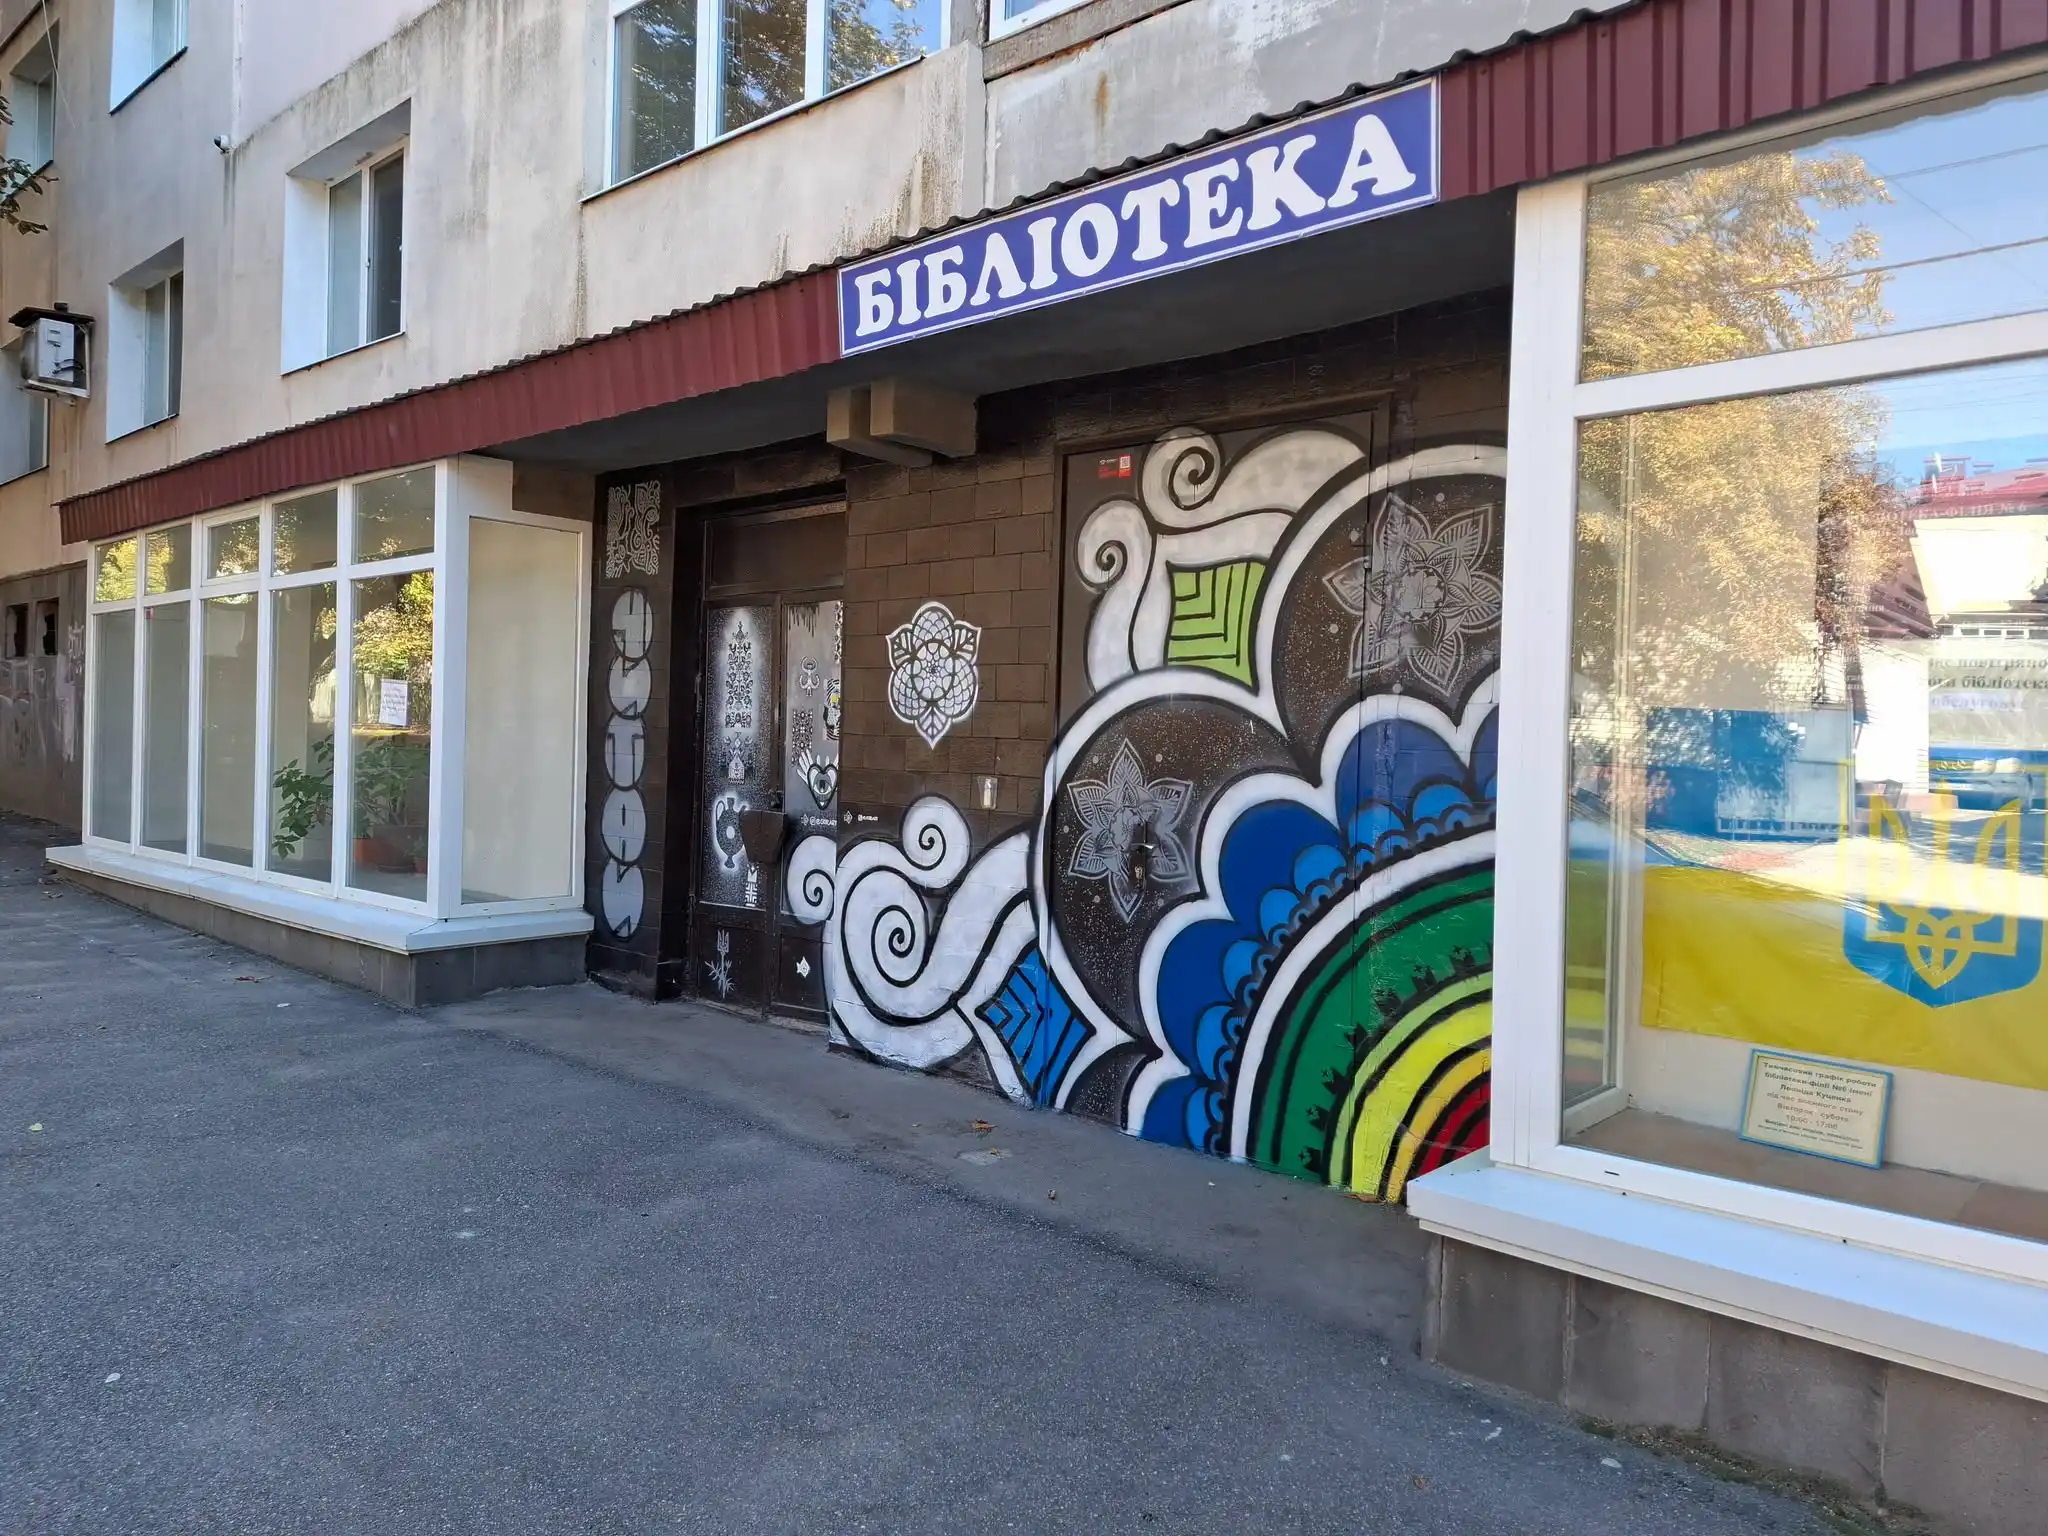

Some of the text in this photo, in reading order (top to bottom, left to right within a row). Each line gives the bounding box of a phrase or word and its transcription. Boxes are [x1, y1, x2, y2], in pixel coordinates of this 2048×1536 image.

[853, 113, 1417, 337] БІБЛІОТЕКА
[1815, 1071, 1843, 1082] графік
[1845, 1077, 1876, 1088] роботи
